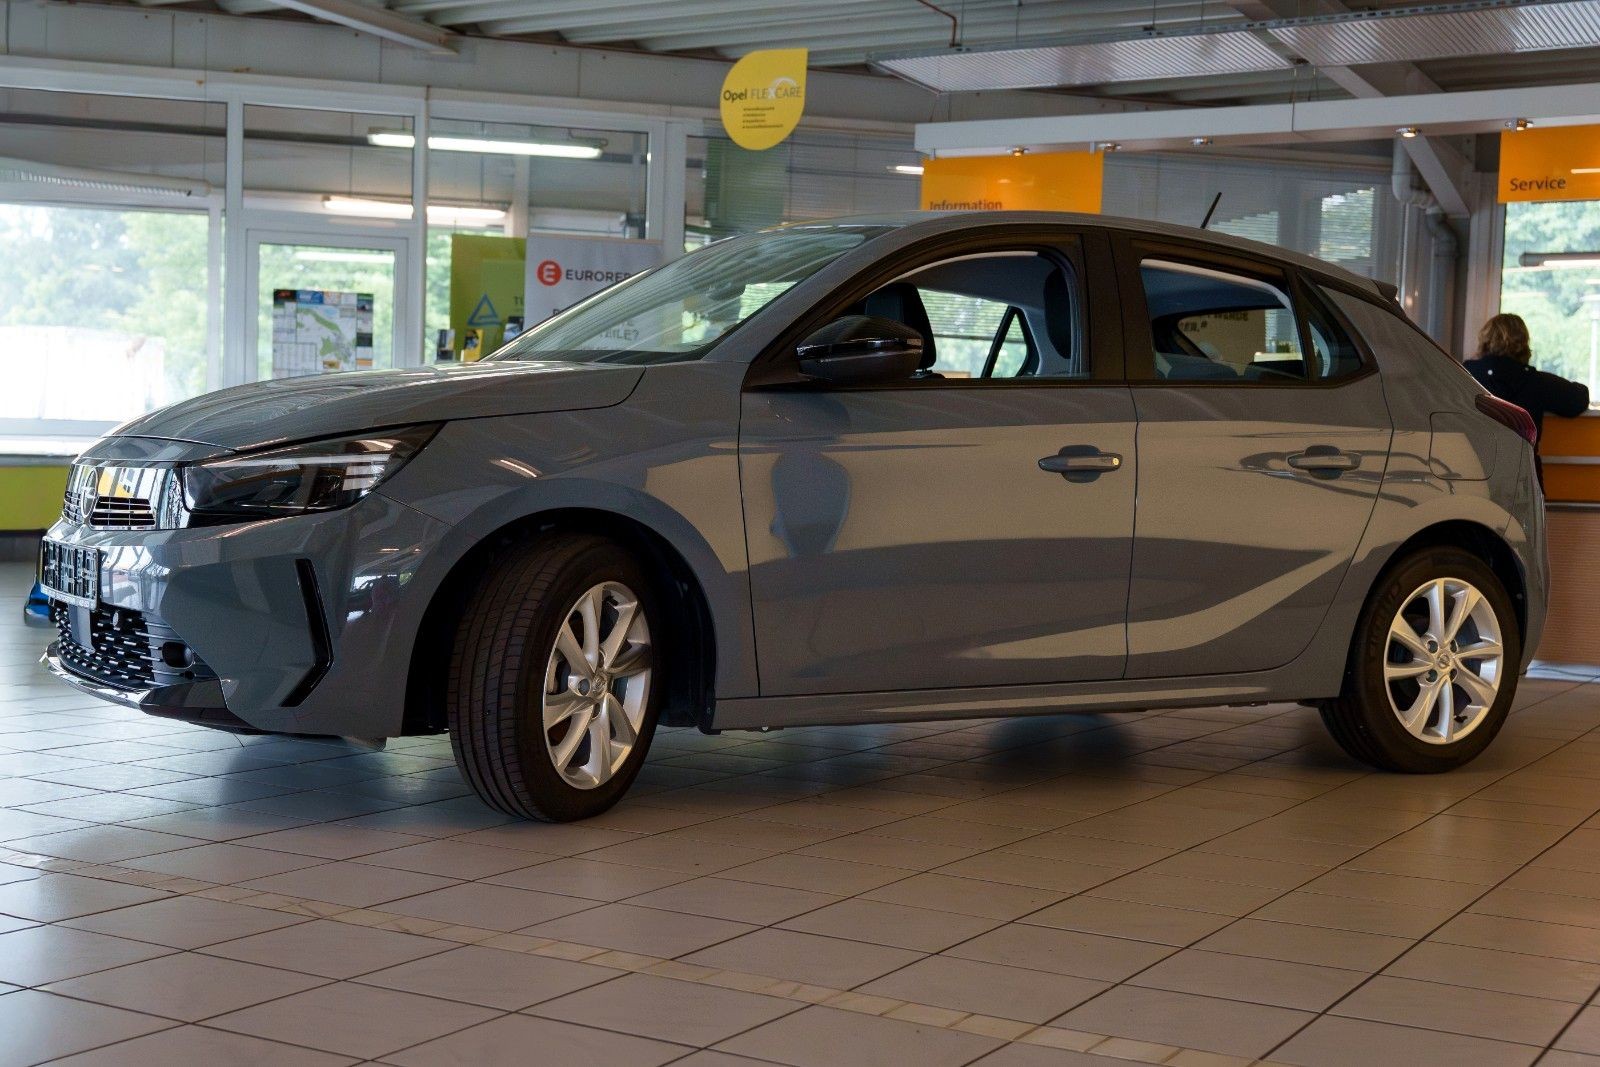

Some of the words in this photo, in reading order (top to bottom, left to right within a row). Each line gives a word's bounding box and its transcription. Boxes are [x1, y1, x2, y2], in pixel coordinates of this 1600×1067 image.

[723, 88, 748, 103] Opel
[751, 86, 802, 100] FLEXCARE
[1510, 176, 1566, 191] Service
[930, 200, 1003, 210] Information
